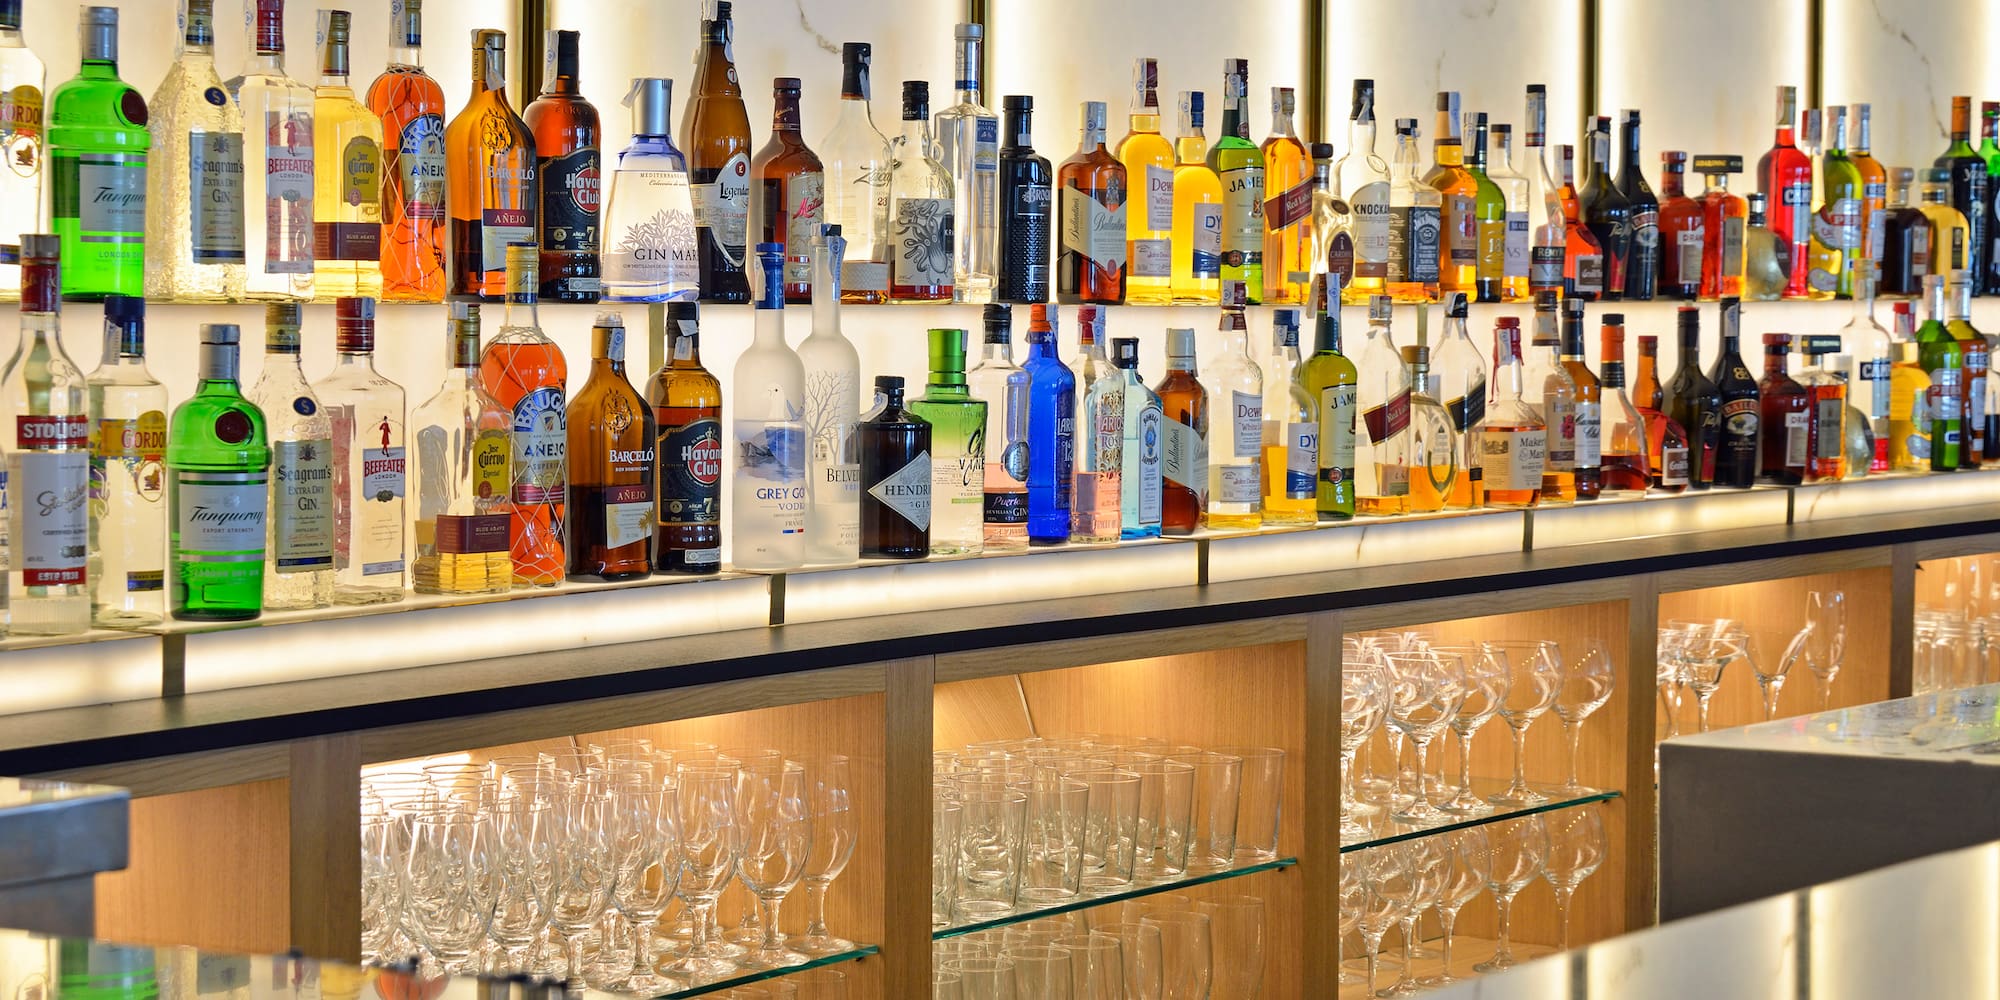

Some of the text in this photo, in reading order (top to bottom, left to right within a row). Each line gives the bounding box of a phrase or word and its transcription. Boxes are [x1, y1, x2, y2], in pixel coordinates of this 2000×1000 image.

[194, 156, 243, 176] Seagram's
[268, 158, 314, 176] BEEFEATER
[877, 197, 889, 207] 23
[494, 212, 526, 224] AÑEJO
[586, 226, 596, 243] 7
[634, 248, 667, 261] GIN
[478, 450, 505, 469] Cuervo
[609, 446, 654, 464] BARCELÓ
[277, 464, 332, 484] Seagram's
[364, 458, 406, 477] BEEFEATER
[693, 459, 719, 476] Club
[288, 485, 325, 496] EXTRA DRY
[617, 489, 647, 501] AÑEJO
[756, 487, 789, 500] GREY
[703, 497, 713, 514] 7
[1012, 507, 1029, 517] GIN
[189, 505, 264, 526] Tanqueray
